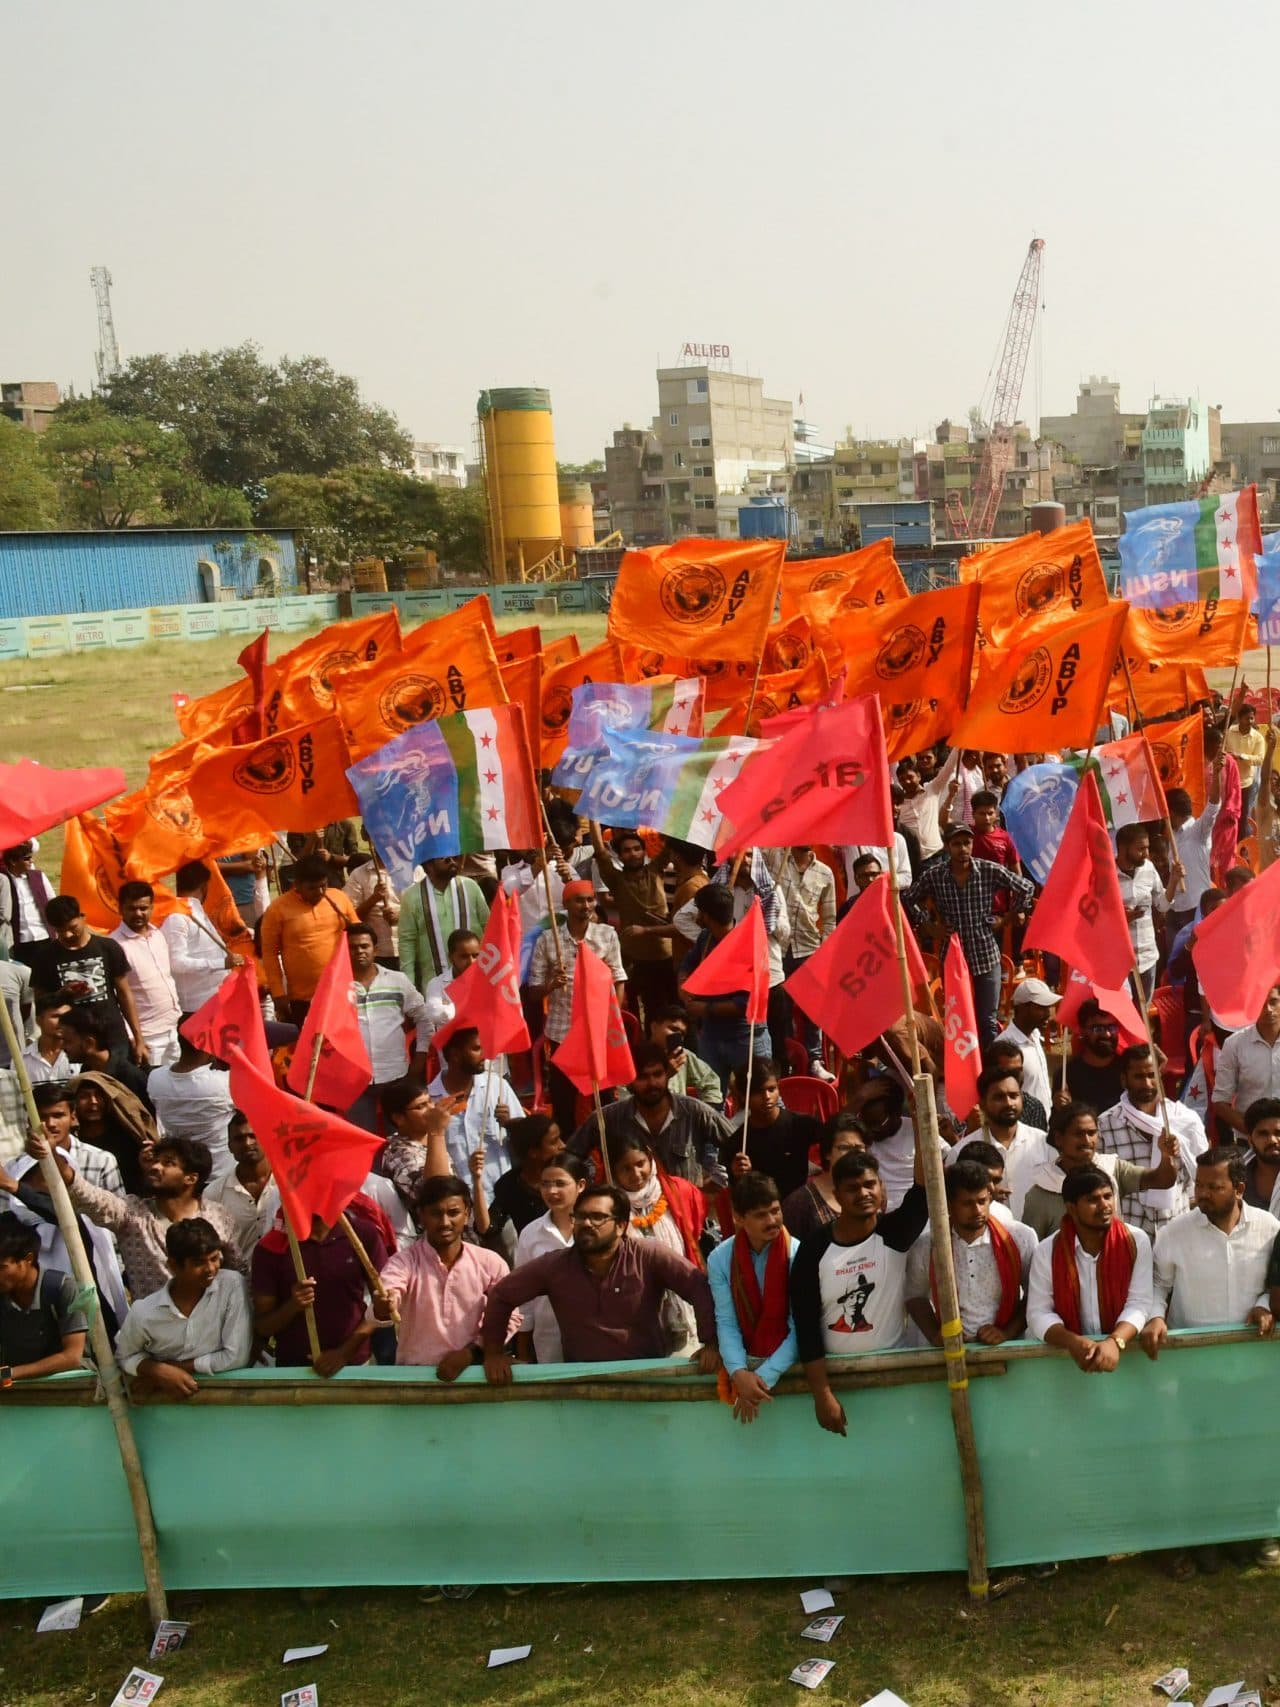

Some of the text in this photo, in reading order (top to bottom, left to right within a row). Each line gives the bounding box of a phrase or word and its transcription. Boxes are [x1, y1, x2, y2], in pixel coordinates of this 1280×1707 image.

[684, 343, 730, 358] ALLIED
[720, 569, 750, 626] ABVP
[1069, 554, 1083, 611] ABVP
[1198, 586, 1219, 636] ABVP
[75, 632, 104, 641] METRO
[925, 616, 946, 668] ABVP
[447, 664, 467, 709] ABV
[1051, 642, 1080, 716] ABVP
[298, 732, 315, 795] ABVP
[155, 1639, 166, 1655] 5
[139, 1681, 155, 1698] 5
